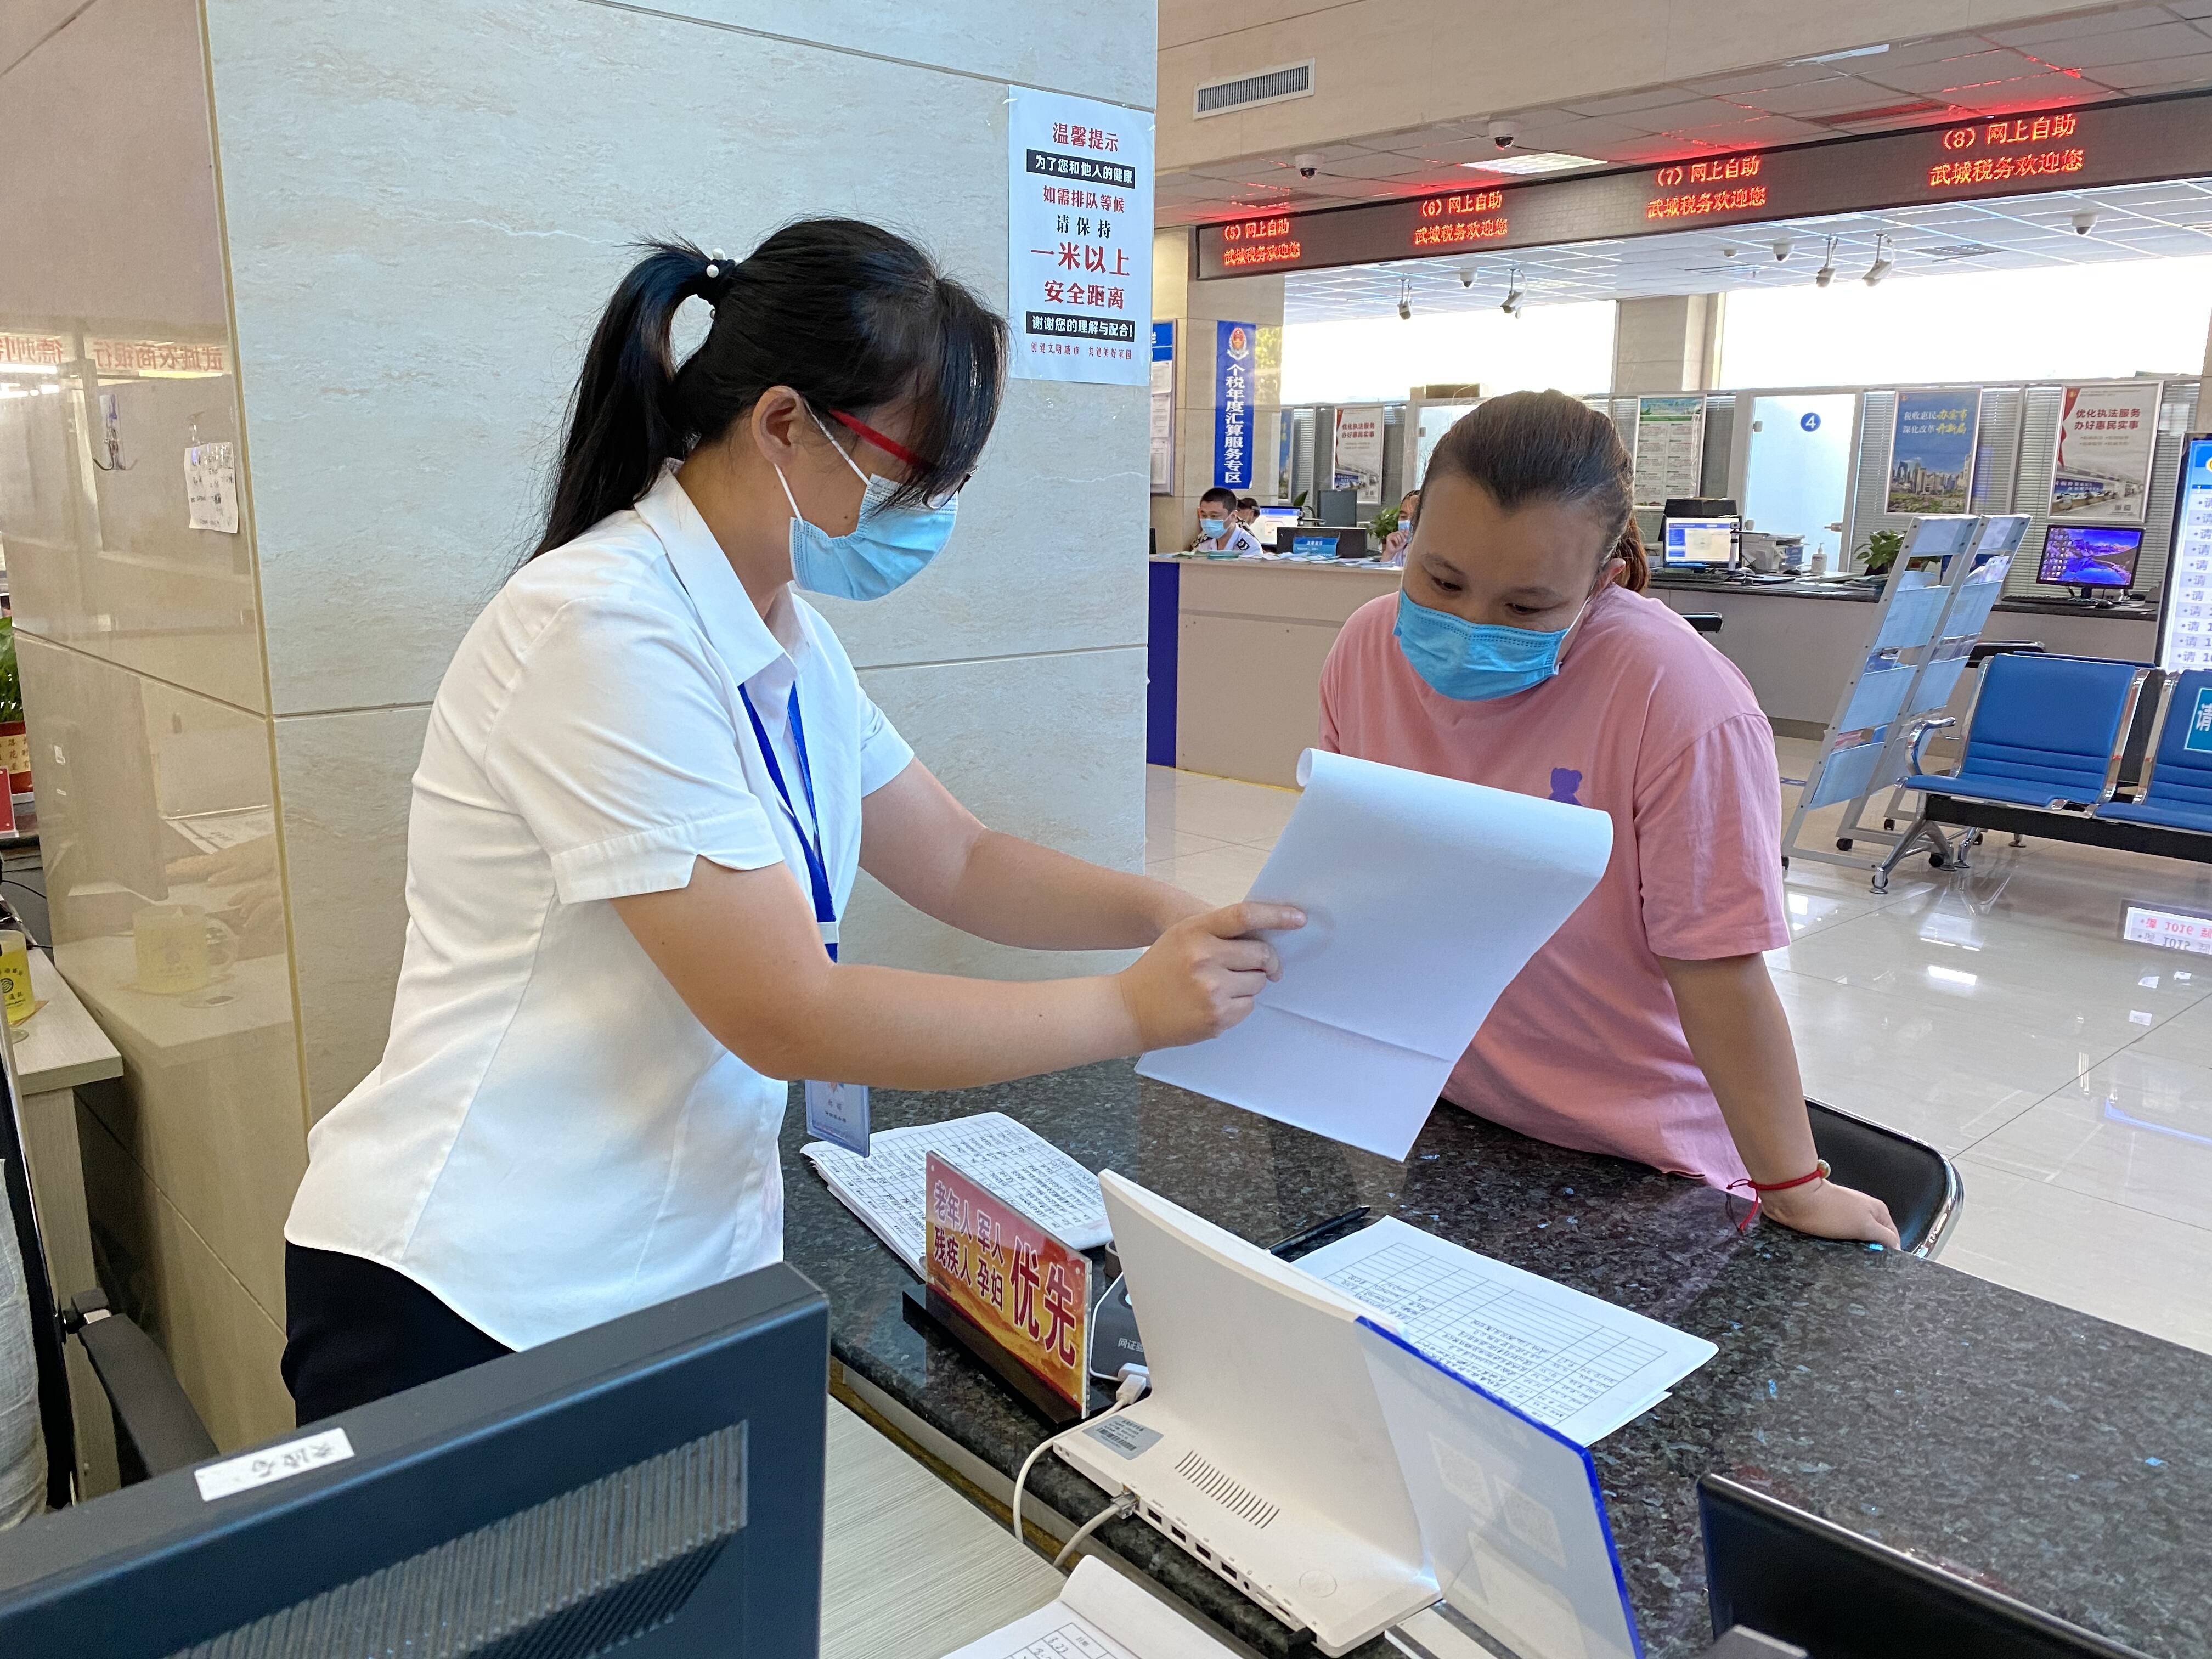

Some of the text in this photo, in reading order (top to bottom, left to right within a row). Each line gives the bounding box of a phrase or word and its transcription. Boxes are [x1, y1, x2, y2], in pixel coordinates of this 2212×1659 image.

[1053, 122, 1119, 153] 温馨提示
[1035, 154, 1133, 185] 为了您和他人的健康
[1930, 149, 2084, 187] 武城税务欢迎您
[1043, 185, 1125, 213] 如需排队等候
[1646, 187, 1766, 219] 武城税务欢迎您
[1056, 215, 1111, 239] 请保持
[1415, 218, 1508, 245] 武城税务欢迎您
[1030, 242, 1130, 276] 一米以上
[1223, 242, 1301, 266] 武城税务欢迎您
[1044, 280, 1125, 310] 安全距离
[1032, 315, 1133, 338] 谢谢您的理解与配合!
[1088, 346, 1132, 360] 共建美好家园
[1224, 364, 1245, 483] 个税年度汇算服务专区
[1805, 415, 1816, 428] 4
[2074, 420, 2140, 430] 办好惠民实事
[2076, 408, 2141, 418] 优化执法服务
[2196, 703, 2212, 732] 请
[934, 1180, 972, 1242] 老年人
[977, 1210, 1005, 1265] 军人
[934, 1227, 1004, 1312] 残疾人 孕妇
[1009, 1235, 1077, 1369] 优先
